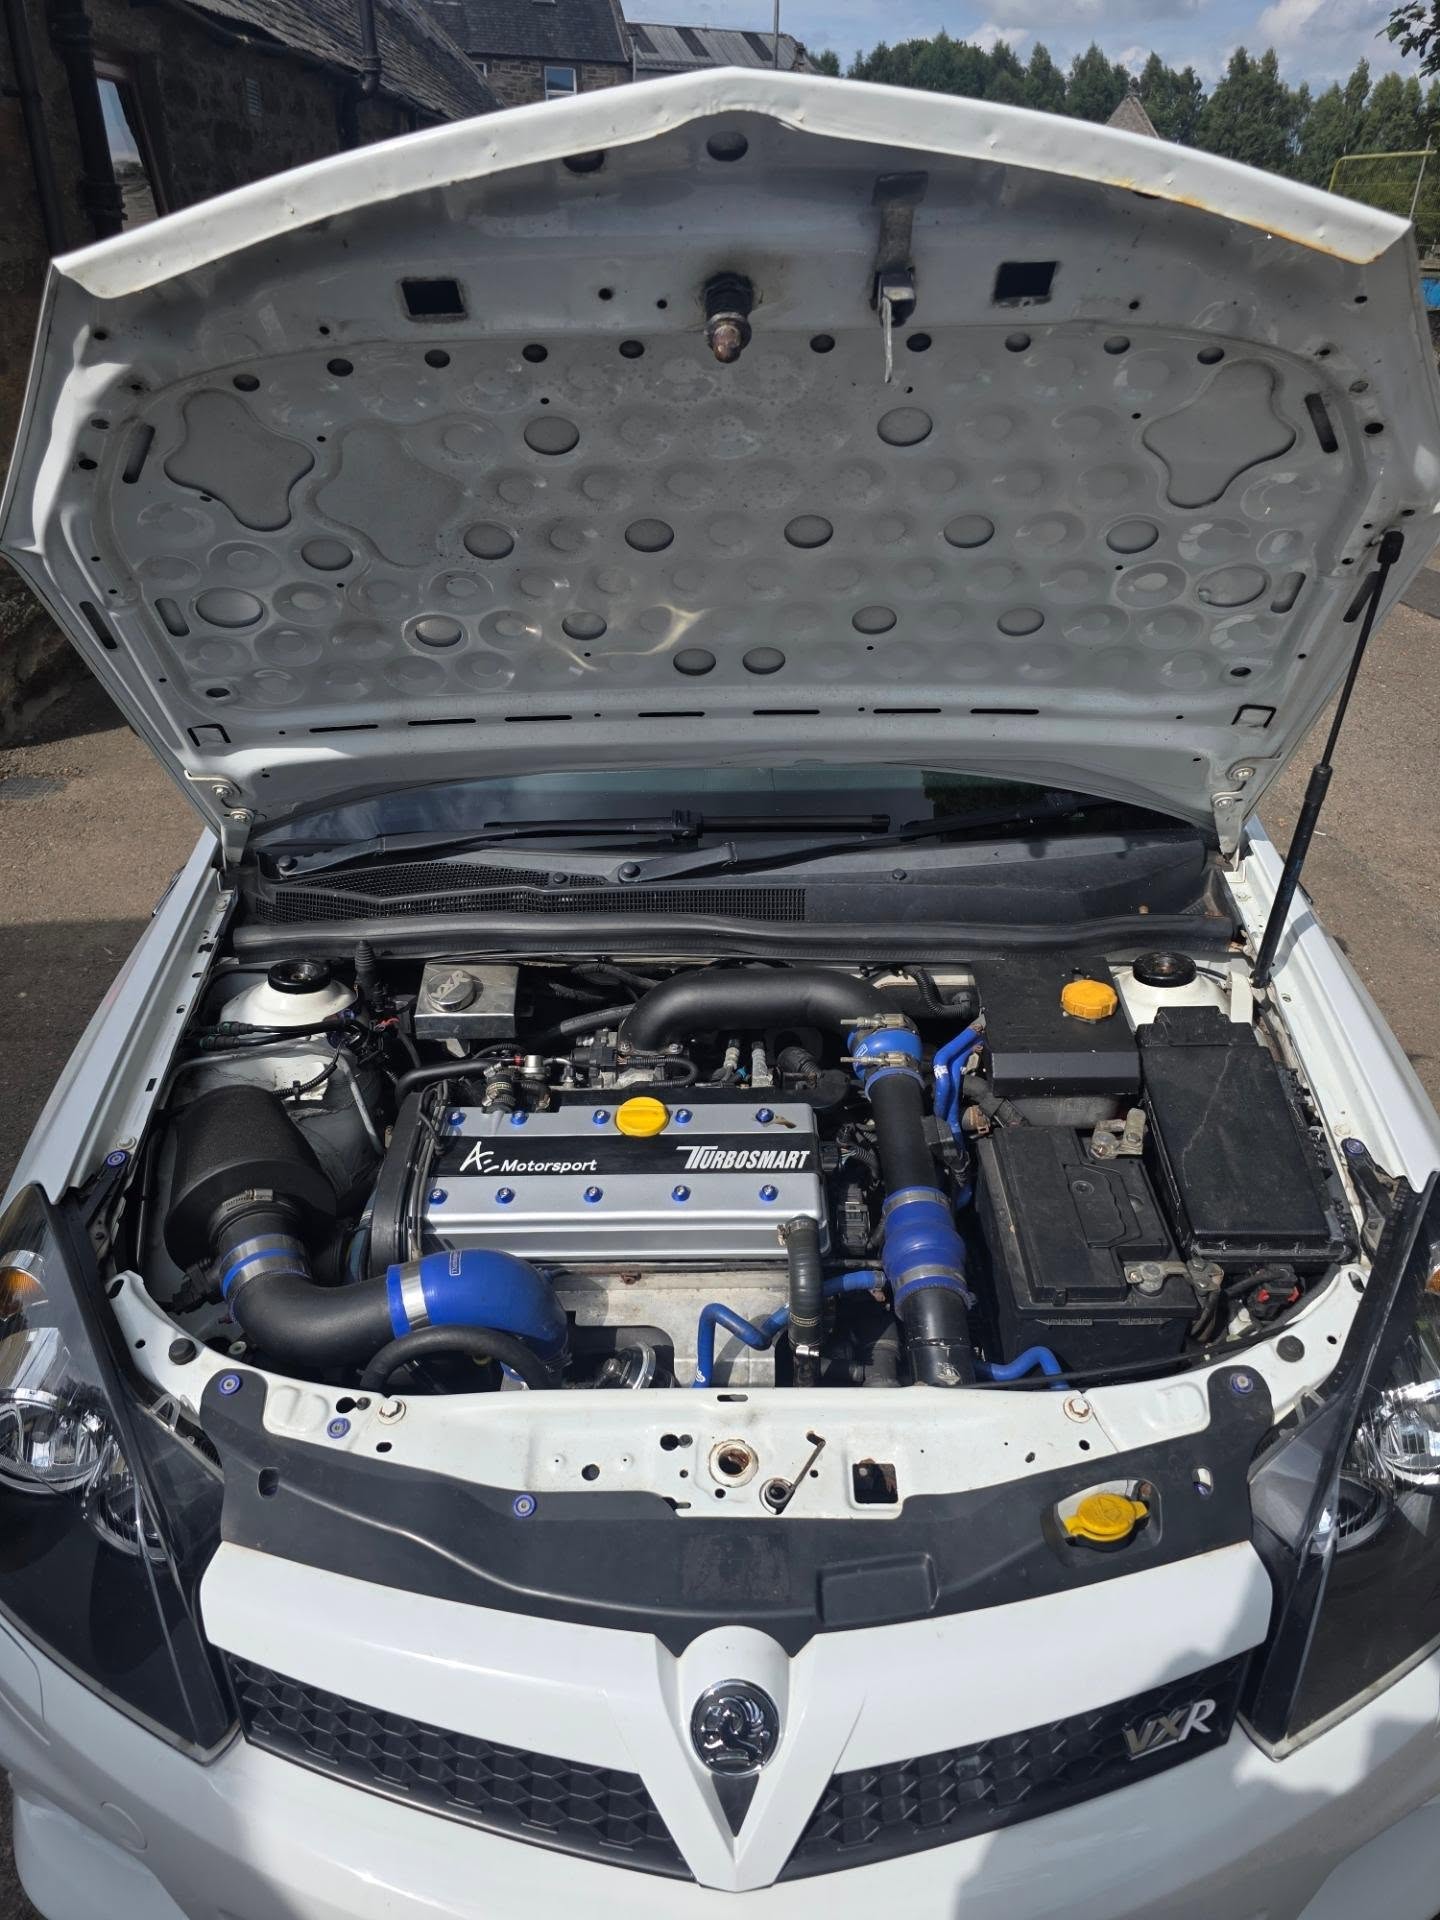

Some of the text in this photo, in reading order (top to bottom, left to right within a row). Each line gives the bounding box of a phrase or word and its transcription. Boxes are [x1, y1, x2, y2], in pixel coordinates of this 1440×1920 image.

[500, 1159, 597, 1173] Motorsport
[676, 1145, 811, 1170] TURBOSMART
[1123, 1698, 1217, 1757] VXR
